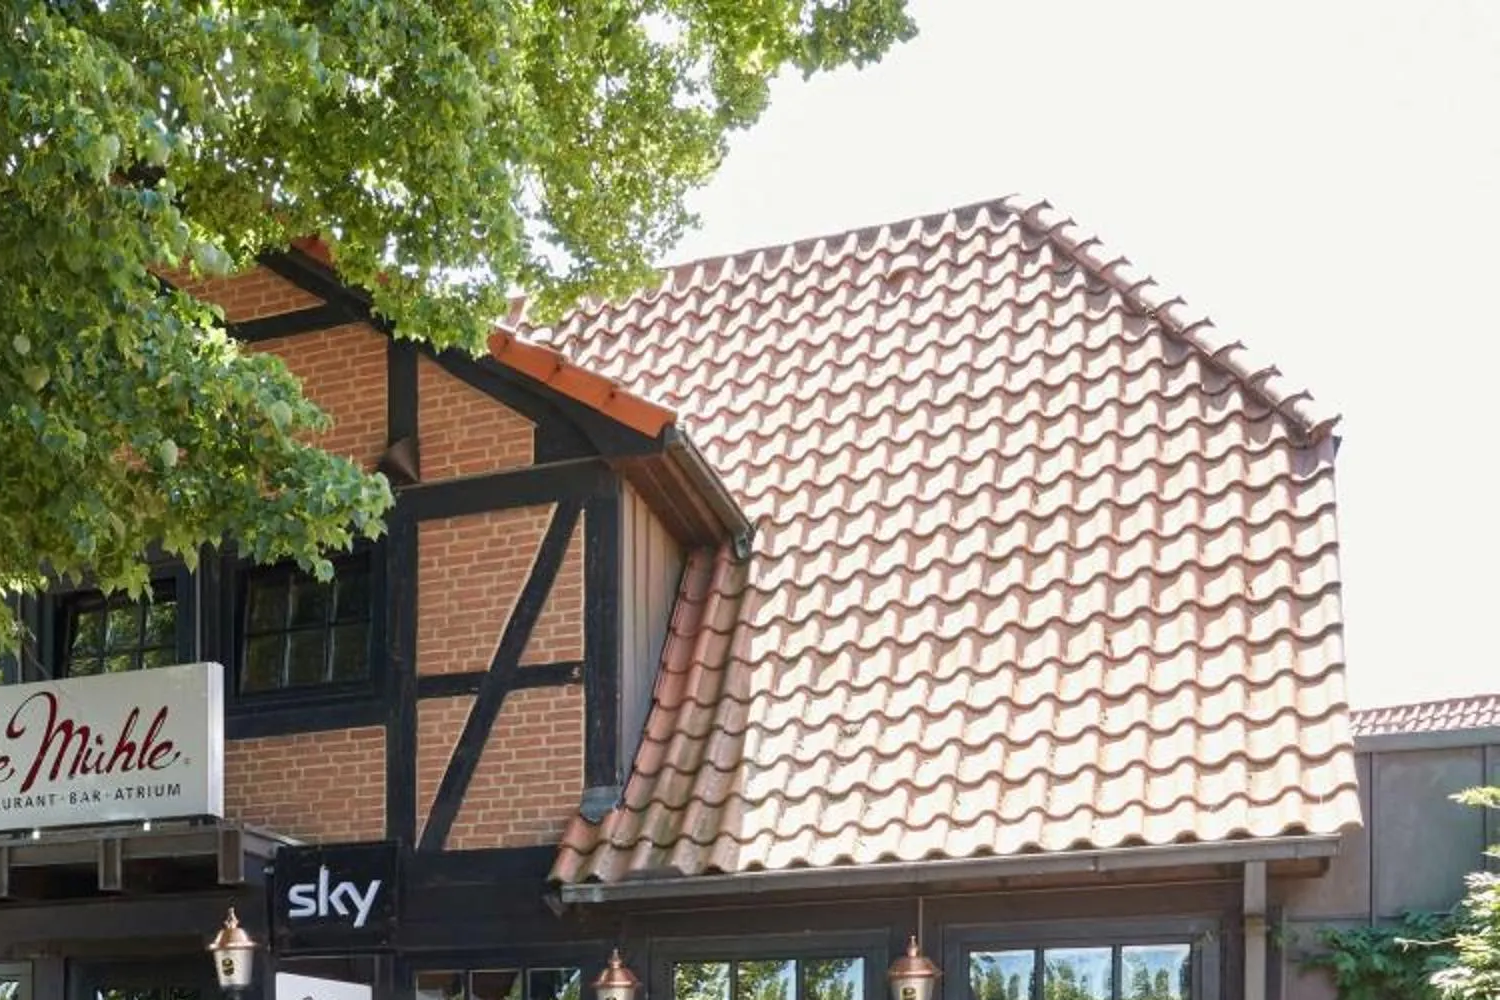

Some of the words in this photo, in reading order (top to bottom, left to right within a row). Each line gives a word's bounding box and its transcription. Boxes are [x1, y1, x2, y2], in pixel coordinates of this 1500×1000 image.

[6, 691, 181, 794] Mühle
[68, 790, 102, 805] BAR
[114, 783, 182, 801] ATRIUM
[288, 864, 381, 928] sky
